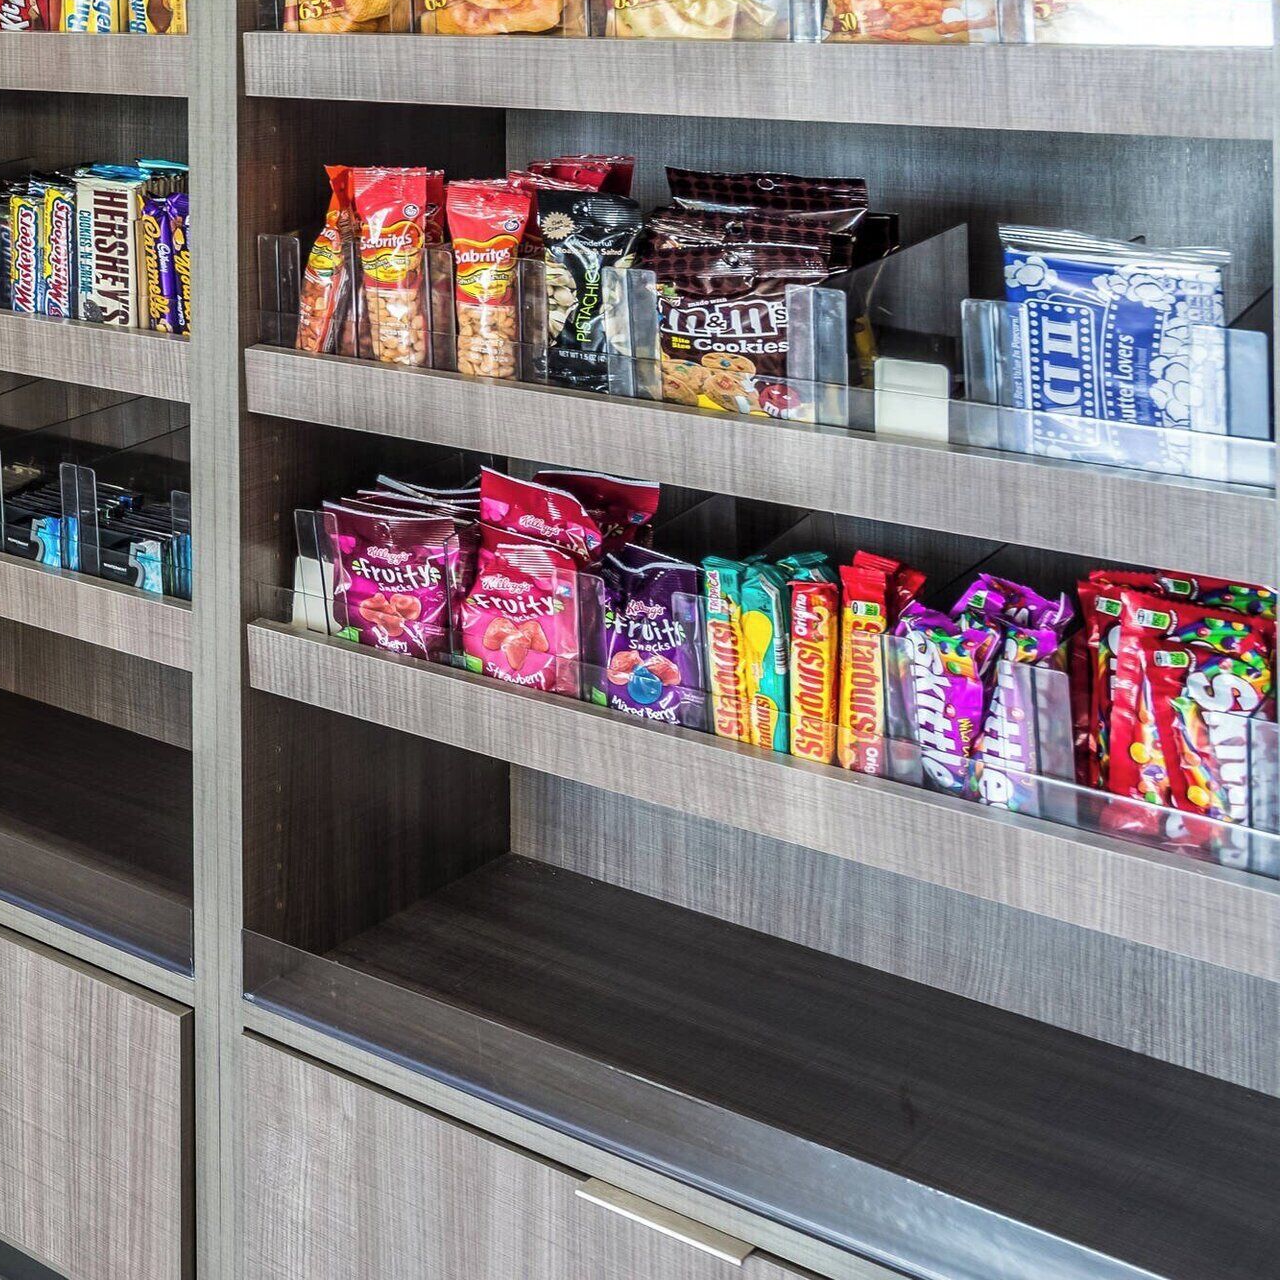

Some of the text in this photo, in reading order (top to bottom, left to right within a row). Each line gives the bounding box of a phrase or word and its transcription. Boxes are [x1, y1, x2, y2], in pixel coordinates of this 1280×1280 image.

[79, 209, 91, 248] COOKIES
[13, 208, 36, 313] Musketeers
[92, 190, 130, 326] HERSHEY'S
[454, 246, 512, 265] Sabritas
[687, 297, 728, 308] made with
[693, 338, 790, 355] Cookies
[1041, 315, 1080, 359] II
[1113, 334, 1135, 381] Lovers
[518, 515, 562, 536] Kellogg's
[366, 545, 413, 564] Kellogg's
[357, 559, 438, 590] Fruity
[472, 593, 556, 617] Fruity
[707, 568, 720, 614] TROPICAL
[613, 615, 684, 648] Fruity
[628, 639, 672, 652] Snacks
[485, 661, 547, 691] Strawberry
[851, 620, 882, 744] Starburst
[611, 695, 678, 722] Mixed Berry
[795, 637, 825, 758] Starburst
